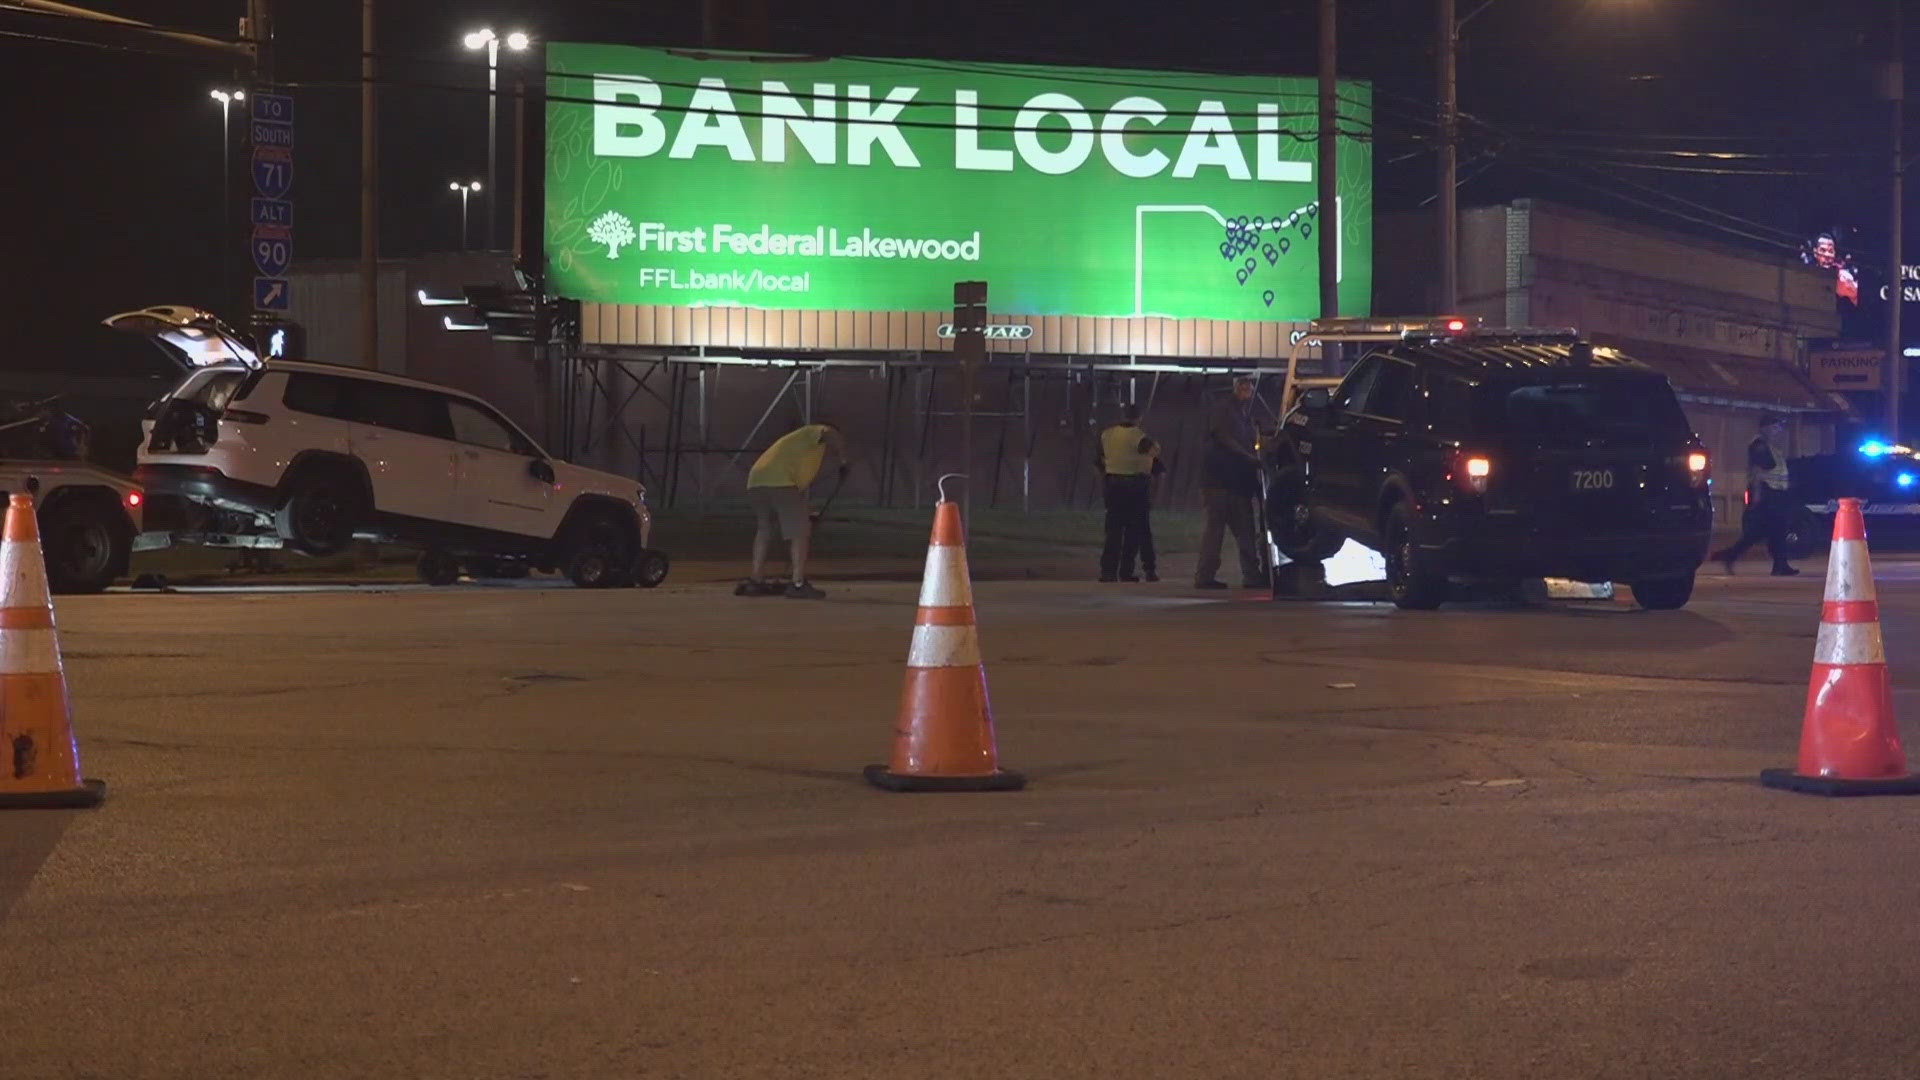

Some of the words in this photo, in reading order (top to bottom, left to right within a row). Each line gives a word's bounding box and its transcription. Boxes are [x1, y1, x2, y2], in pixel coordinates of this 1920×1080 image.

[264, 101, 281, 116] TO
[255, 126, 290, 144] SOUTH
[593, 73, 921, 168] BANK
[955, 89, 1312, 182] LOCAL
[263, 163, 284, 188] 71
[260, 207, 284, 221] ALT
[639, 223, 706, 253] First
[713, 225, 823, 258] Federal
[829, 227, 980, 261] Lakewood
[258, 242, 286, 265] 90
[640, 268, 810, 292] FFL.bank/local
[1821, 357, 1879, 369] PARKING
[1573, 470, 1613, 489] 7200
